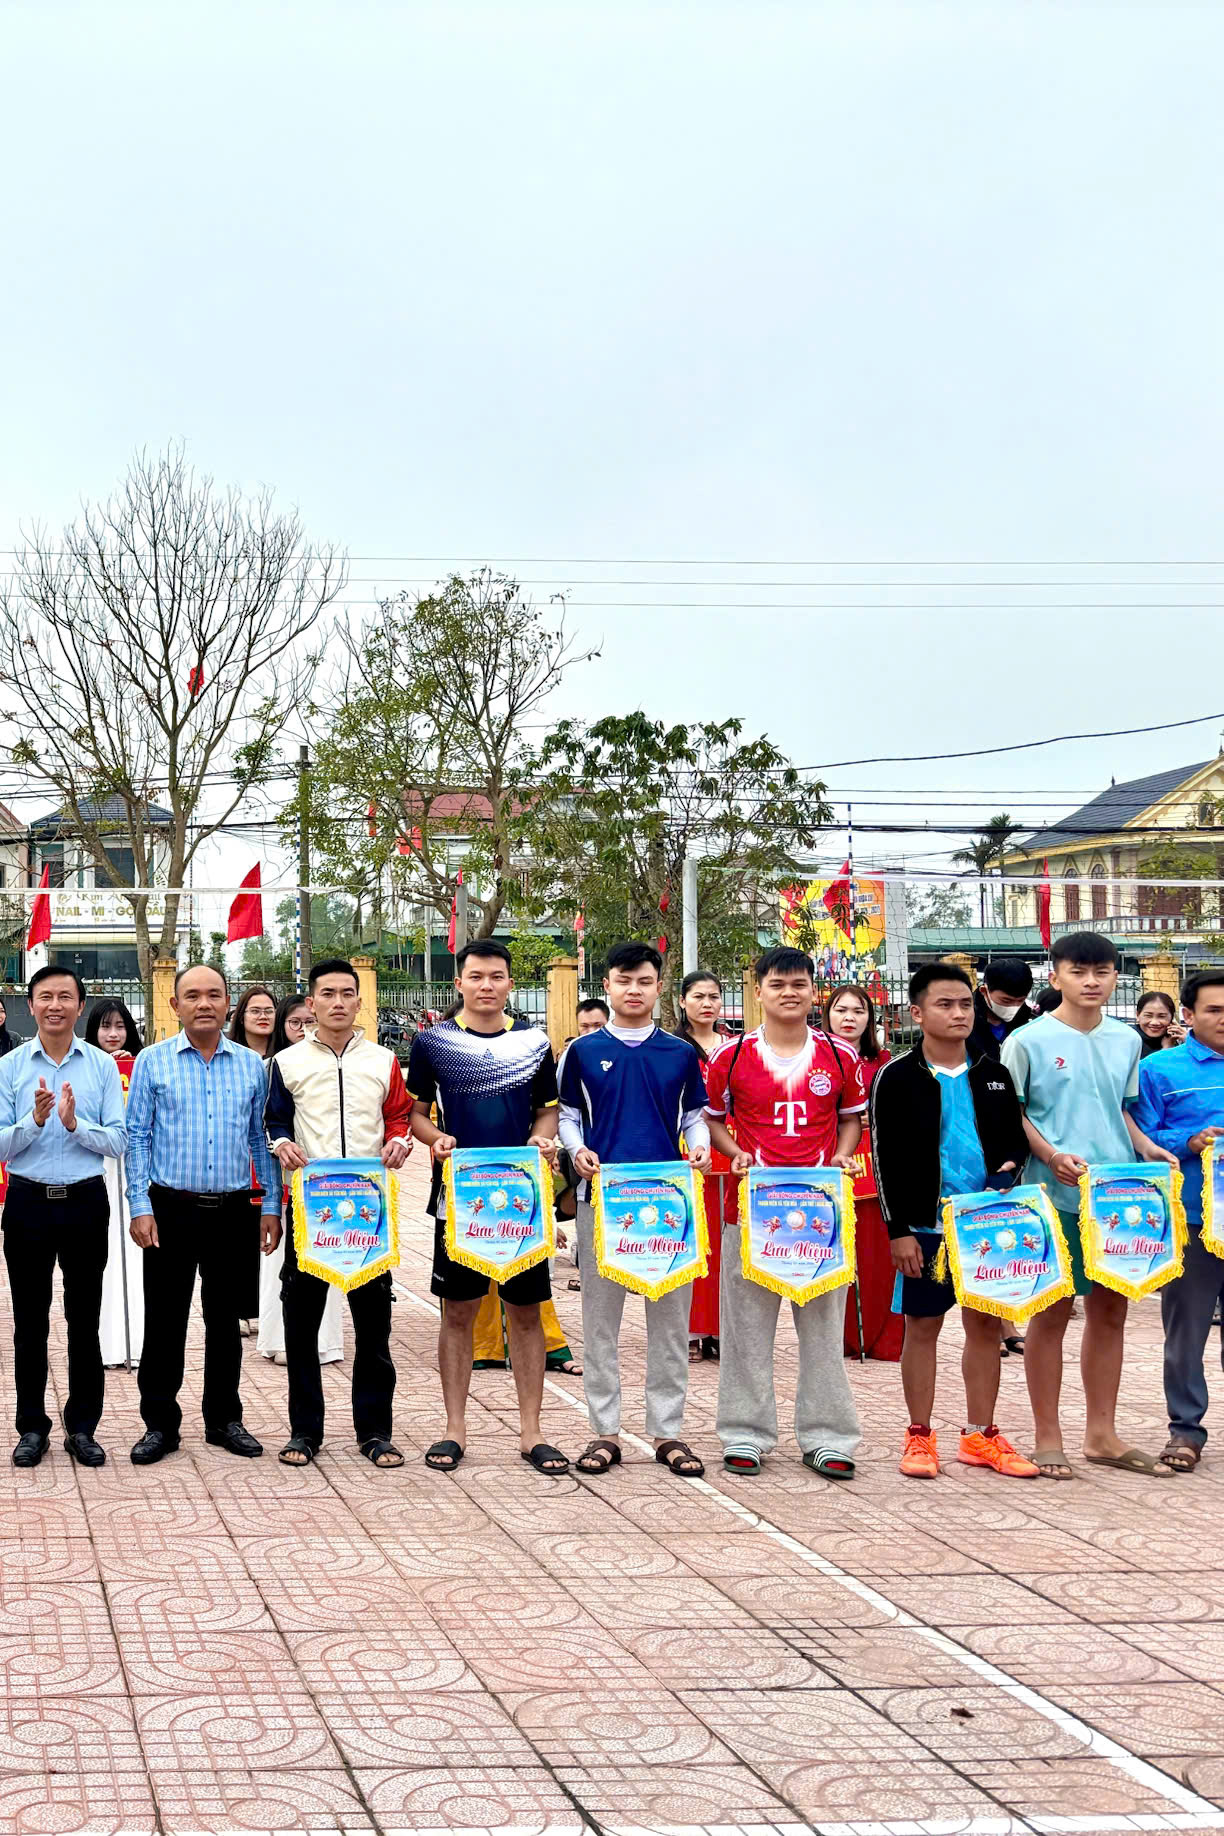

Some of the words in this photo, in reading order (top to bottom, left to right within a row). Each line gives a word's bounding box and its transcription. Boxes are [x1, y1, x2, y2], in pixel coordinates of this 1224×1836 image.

[56, 905, 82, 916] NAIL
[774, 1101, 808, 1137] T
[313, 1230, 341, 1248] Lưu
[344, 1229, 381, 1251] Niệm
[465, 1220, 495, 1239] Lưu
[497, 1219, 536, 1240] Niệm
[615, 1236, 646, 1255] Lưu
[648, 1235, 688, 1257] Niệm
[760, 1240, 791, 1259] Lưu
[793, 1241, 835, 1263] Niệm
[1104, 1237, 1129, 1255] Lưu
[1131, 1236, 1166, 1258] Niệm
[973, 1264, 1006, 1282] Lưu
[1006, 1259, 1050, 1280] Niệm
